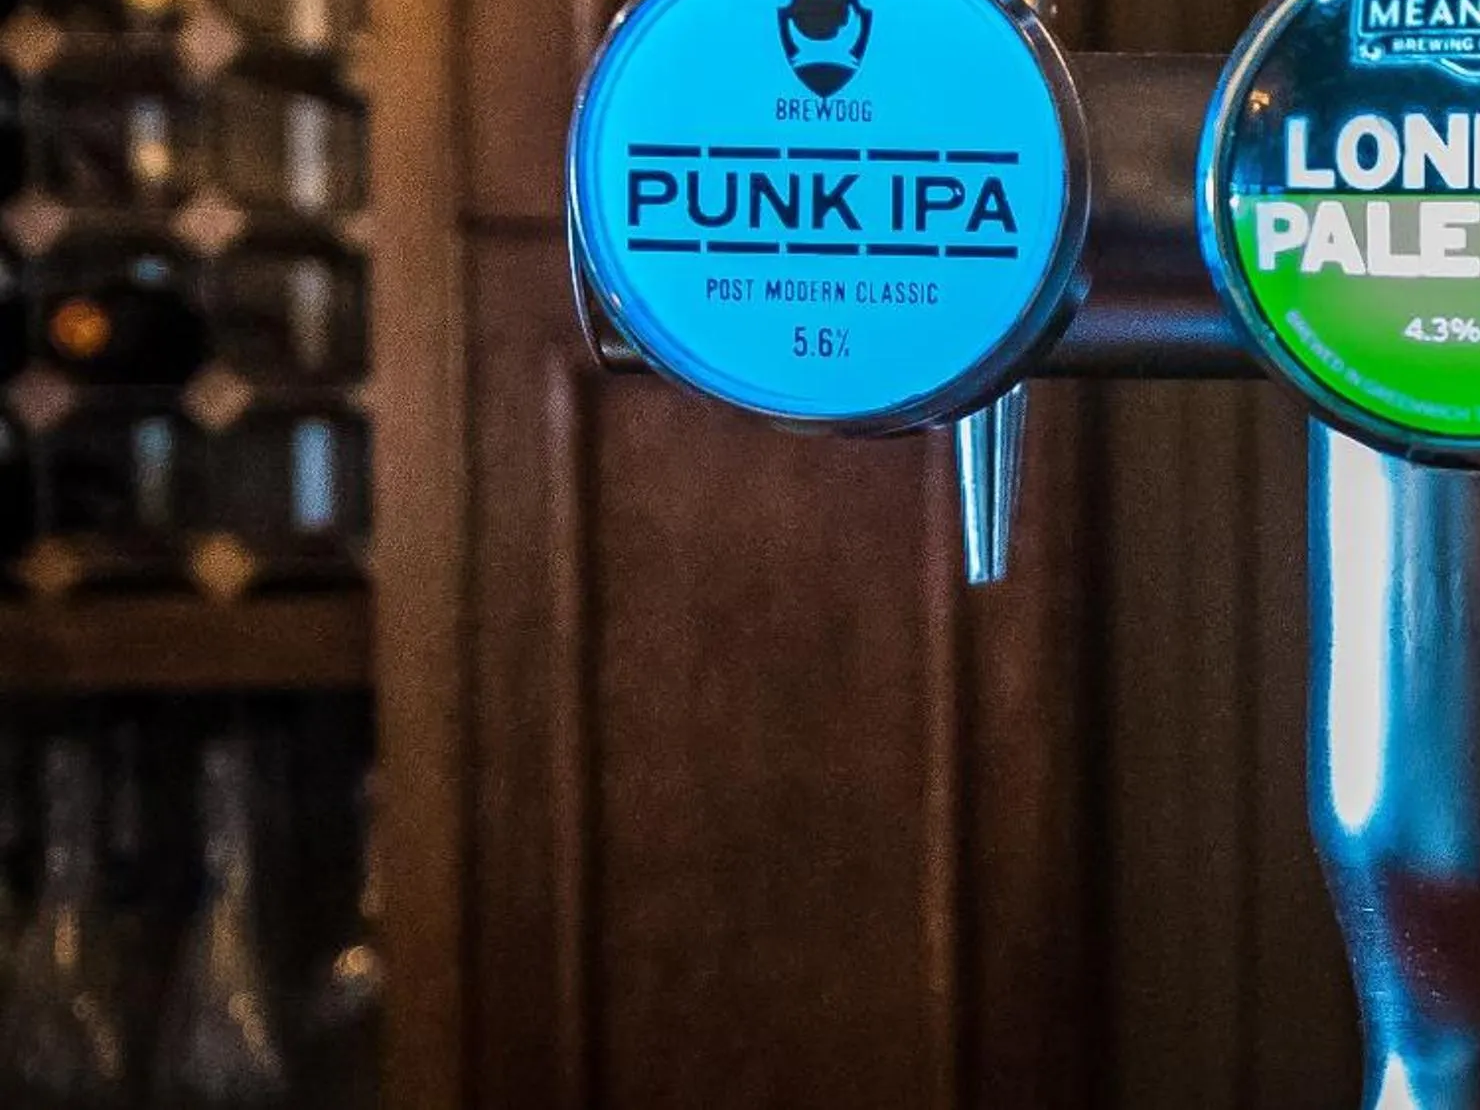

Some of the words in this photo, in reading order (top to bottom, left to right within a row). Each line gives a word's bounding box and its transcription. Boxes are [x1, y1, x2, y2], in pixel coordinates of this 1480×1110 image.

[1391, 36, 1474, 54] BREWING
[775, 97, 873, 123] BREWDOG
[627, 169, 863, 232] PUNK
[890, 174, 1019, 235] IPA
[706, 277, 755, 303] POST
[765, 278, 847, 304] MODERN
[855, 280, 939, 306] CLASSIC
[792, 325, 850, 358] 5.6%
